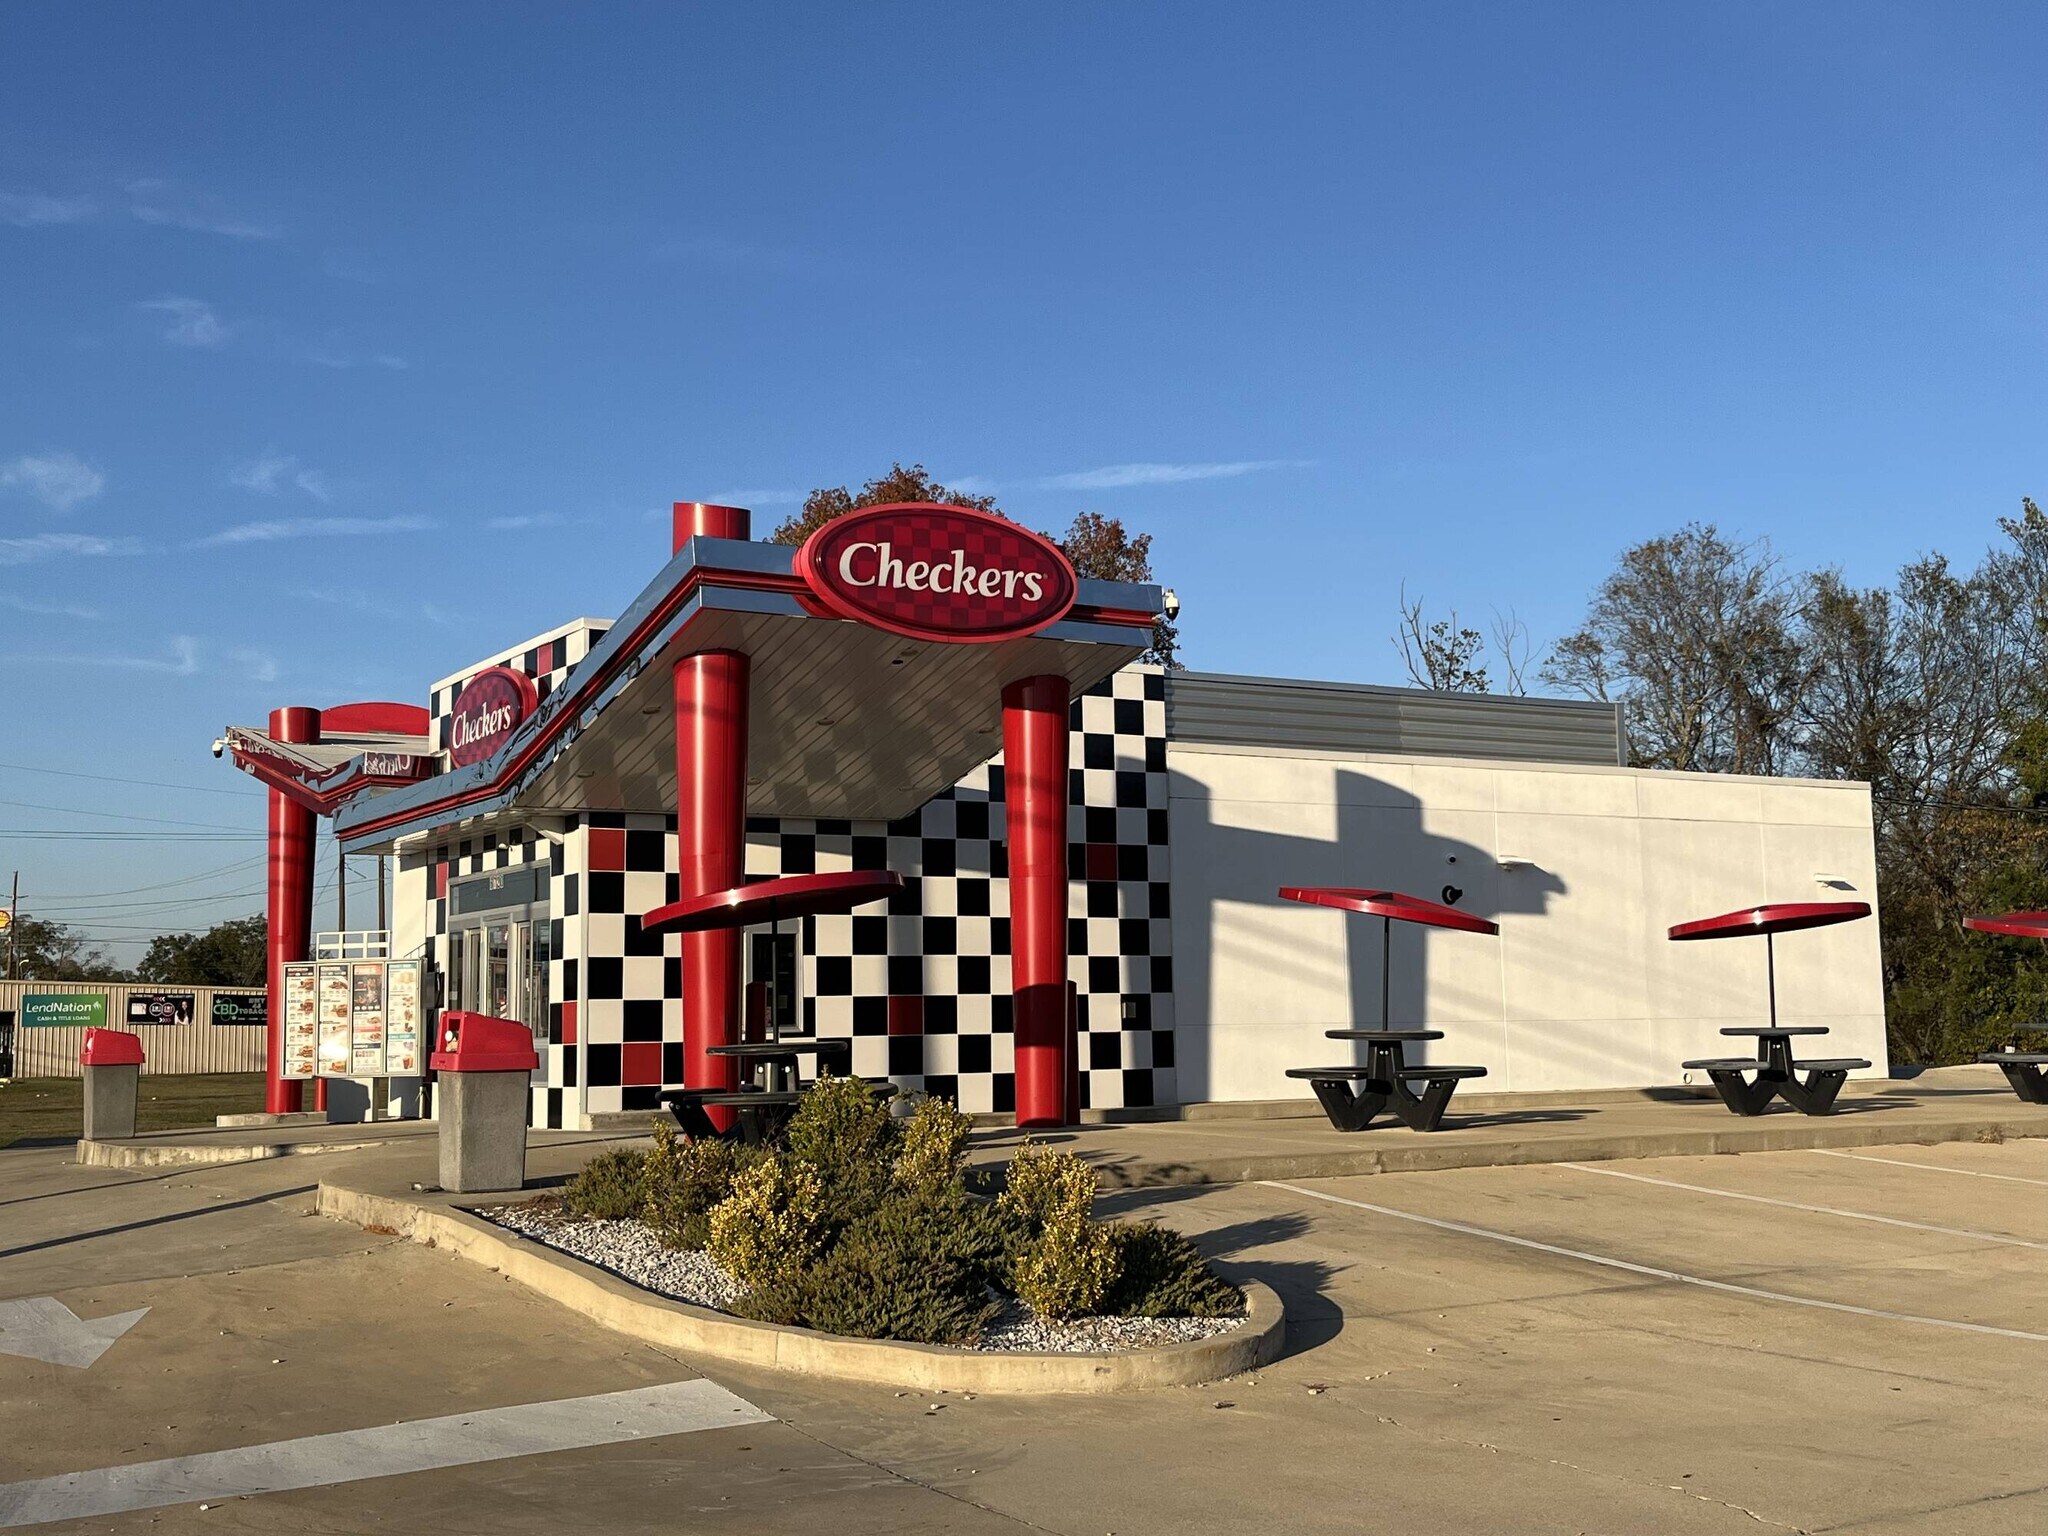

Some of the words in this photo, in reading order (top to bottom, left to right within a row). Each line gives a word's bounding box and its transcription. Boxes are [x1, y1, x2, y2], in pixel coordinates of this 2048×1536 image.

[839, 542, 1044, 601] Checkers
[452, 702, 511, 749] Checkers
[26, 1002, 92, 1013] LendNation
[213, 1004, 239, 1015] CBD
